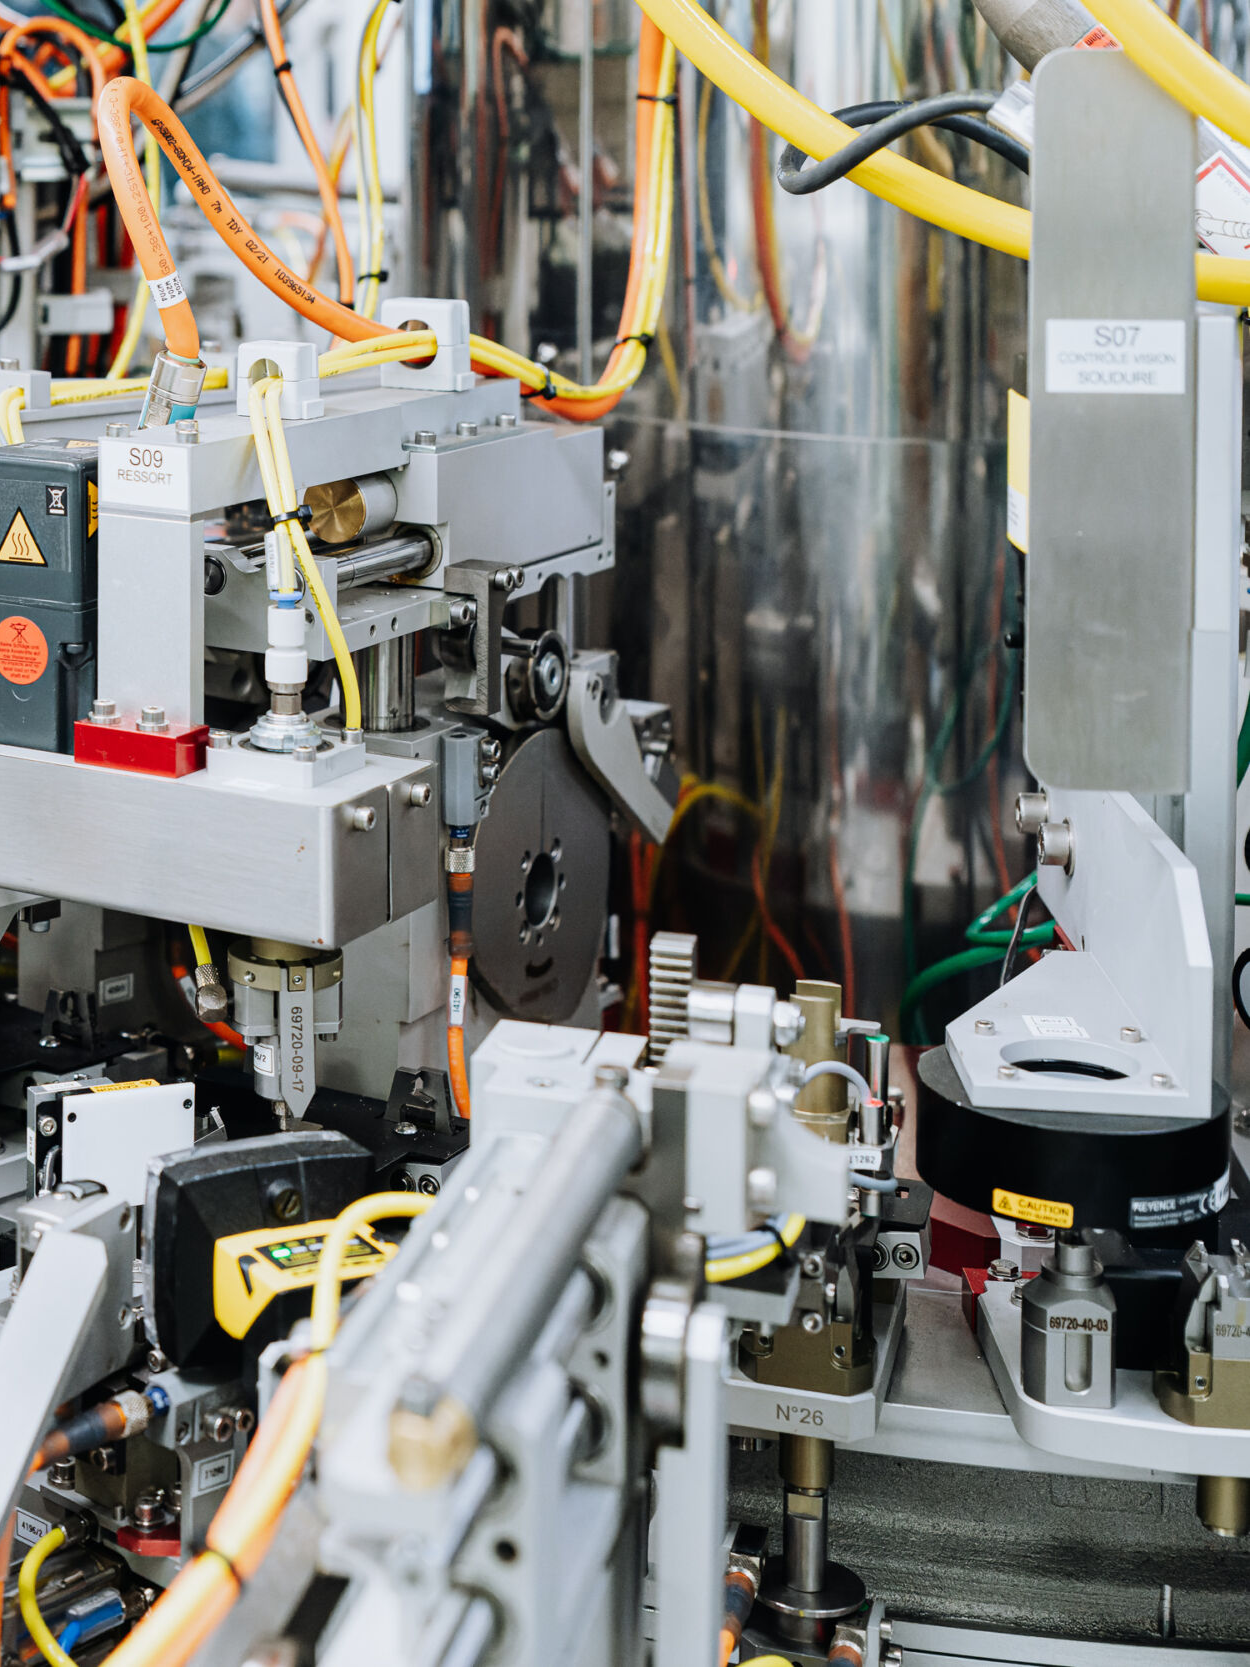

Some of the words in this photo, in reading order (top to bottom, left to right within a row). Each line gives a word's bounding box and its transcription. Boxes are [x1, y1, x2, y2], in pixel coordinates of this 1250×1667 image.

[211, 200, 223, 214] 7m
[226, 217, 243, 235] TDY
[245, 239, 269, 264] 02/21
[274, 268, 316, 304] 103965134
[1095, 325, 1141, 347] S07
[1134, 352, 1176, 364] VISION
[1078, 370, 1157, 385] SOUDURE
[129, 447, 164, 469] S09
[117, 468, 174, 486] RESSORT
[291, 1006, 305, 1094] 69720-09-17
[1018, 1198, 1069, 1217] CAUTION
[1132, 1198, 1177, 1212] KEYENCE
[1050, 1316, 1109, 1332] 69720-40-03
[776, 1403, 824, 1426] N°26
